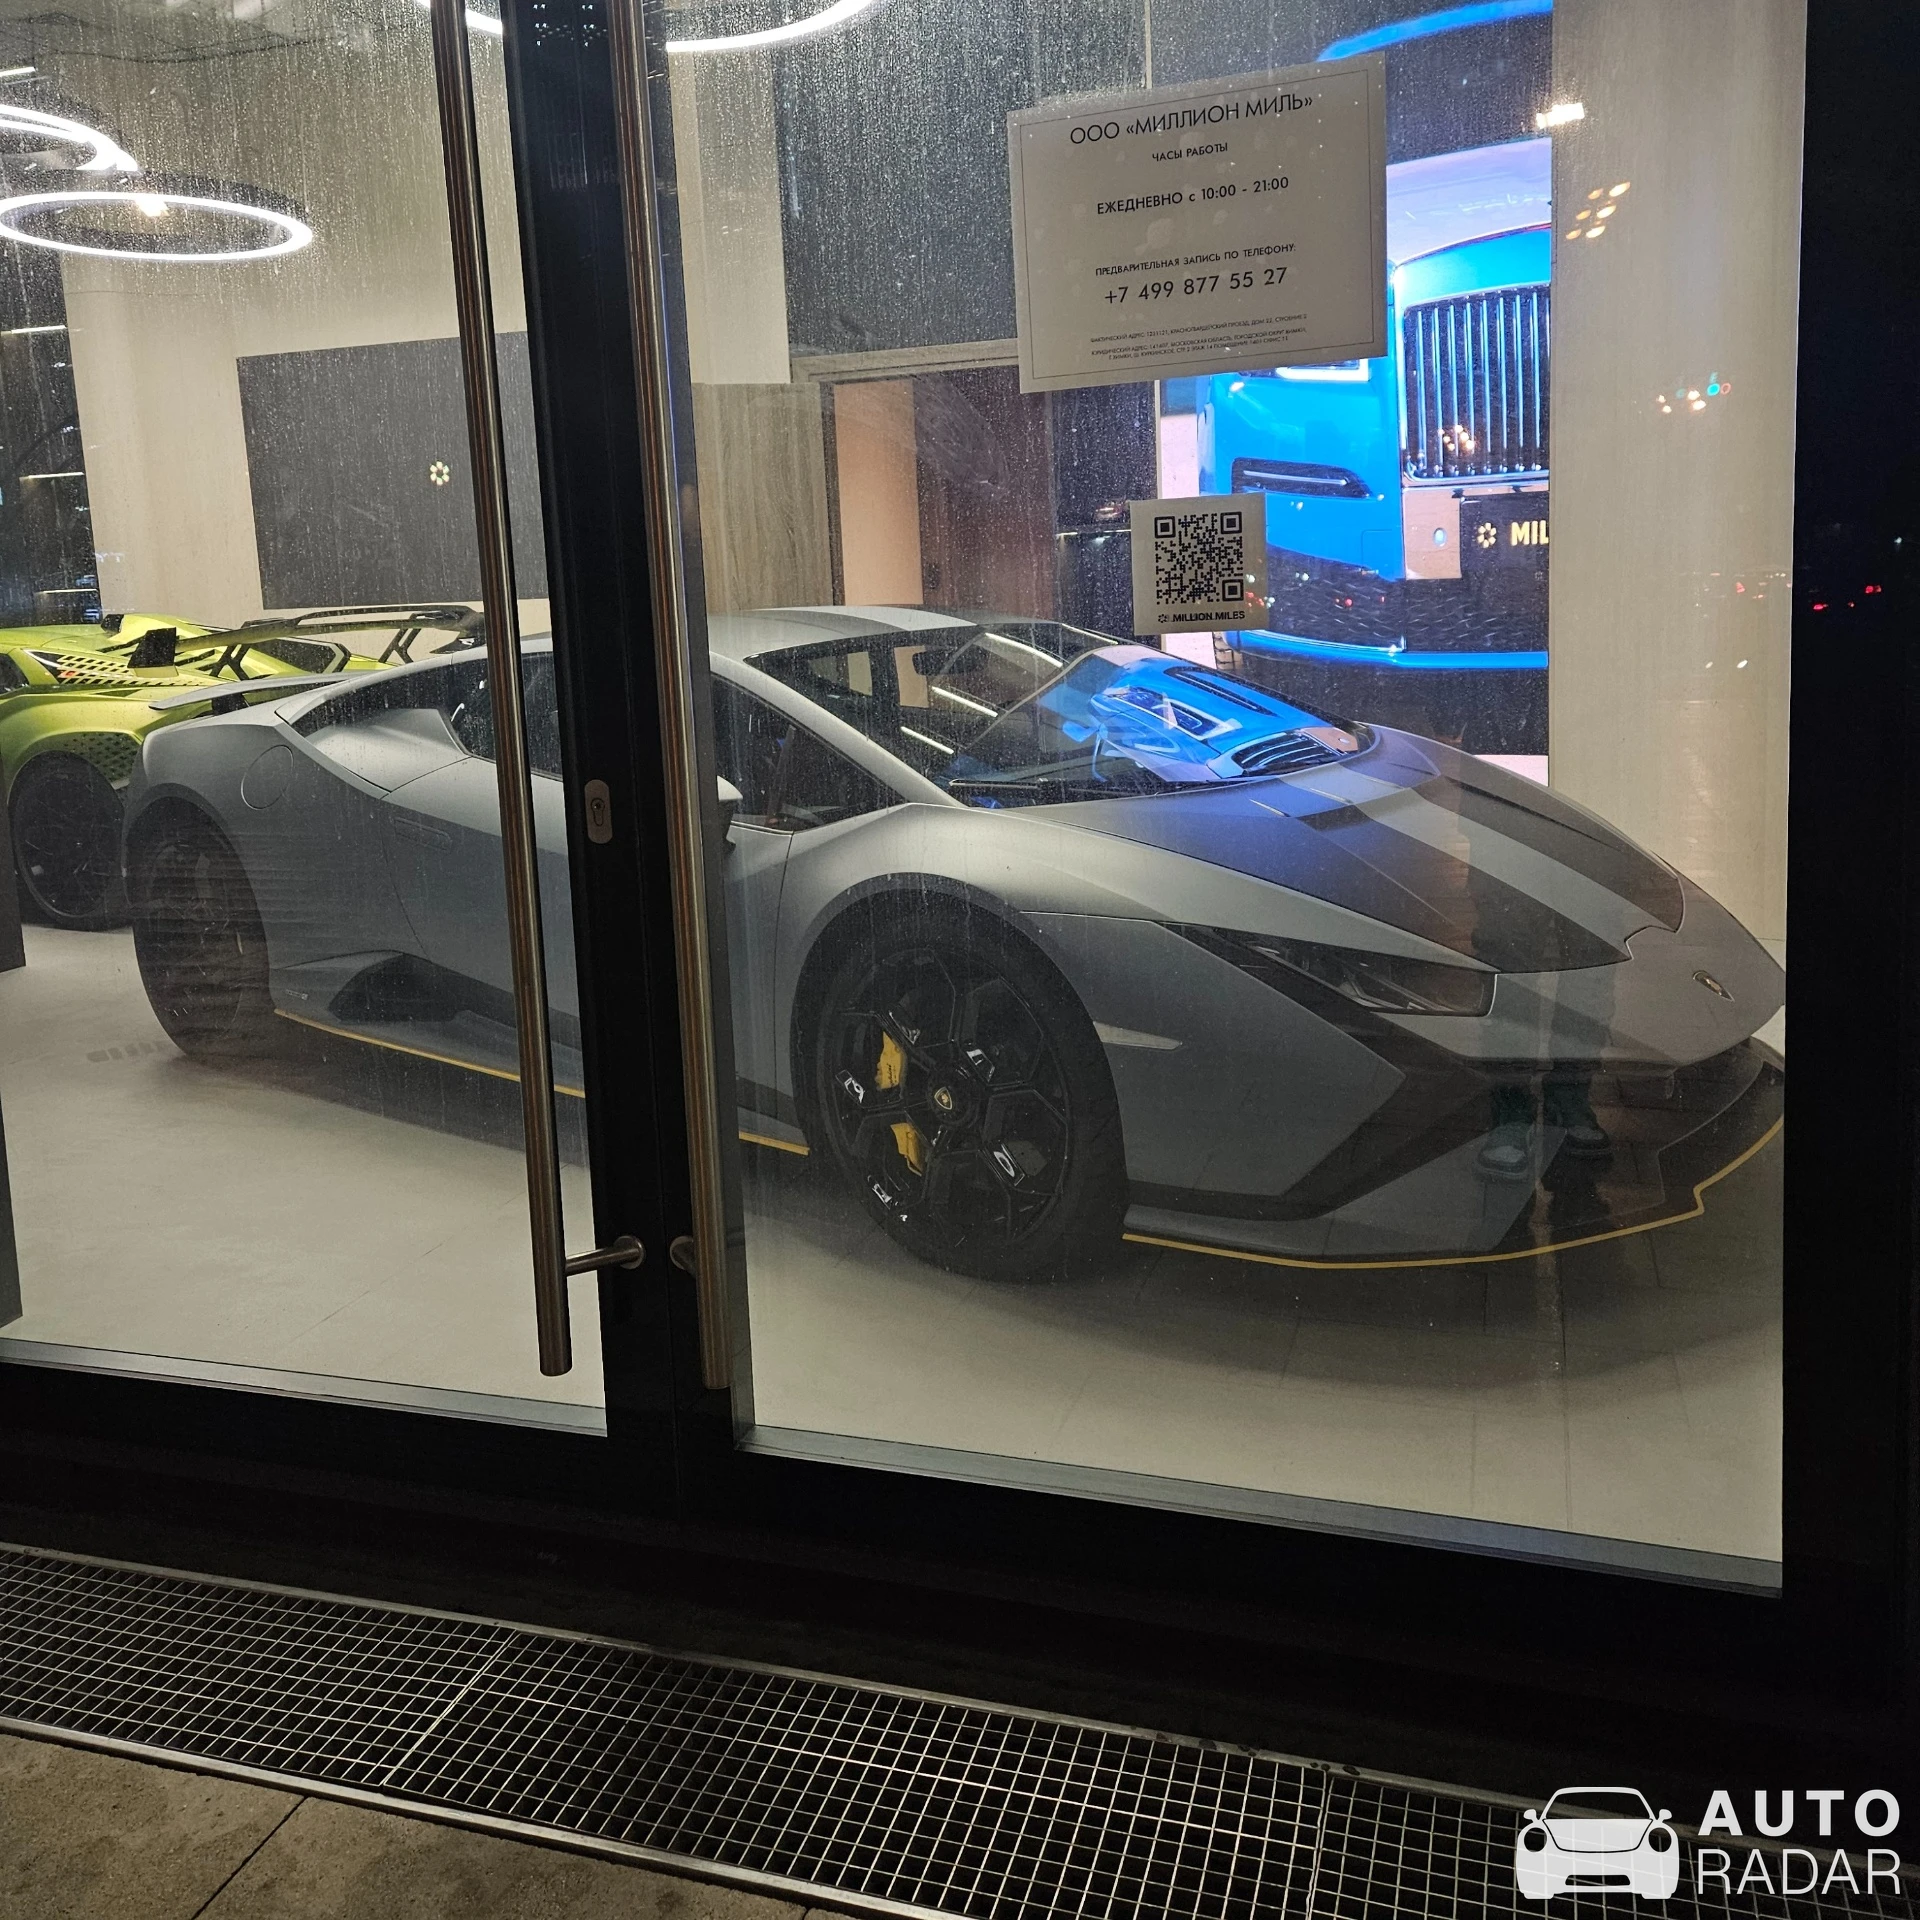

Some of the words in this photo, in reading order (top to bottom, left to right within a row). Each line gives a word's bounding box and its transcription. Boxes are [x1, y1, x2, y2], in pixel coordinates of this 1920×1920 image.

[1070, 122, 1120, 145] ООО
[1127, 103, 1240, 135] «МИЛЛИОН
[1246, 93, 1313, 118] МИЛЬ»
[1152, 150, 1183, 163] ЧАСЫ
[1187, 142, 1228, 158] РАБОТЫ
[1097, 192, 1183, 215] ЕЖЕДНЕВНО
[1189, 194, 1196, 203] с
[1201, 184, 1237, 201] 10:00
[1253, 177, 1289, 194] 21:00
[1096, 258, 1180, 277] ПРЕДВАРИТЕЛЬНАЯ
[1183, 253, 1221, 266] ЗАПИСЬ
[1224, 251, 1240, 261] ПО
[1243, 243, 1297, 258] ТЕЛЕФОНУ:
[1105, 286, 1129, 305] +7
[1138, 281, 1174, 301] 499
[1184, 275, 1220, 296] 877
[1230, 271, 1254, 290] 55
[1264, 267, 1288, 286] 27
[1173, 612, 1213, 622] MILLION
[1215, 611, 1245, 620] MILES
